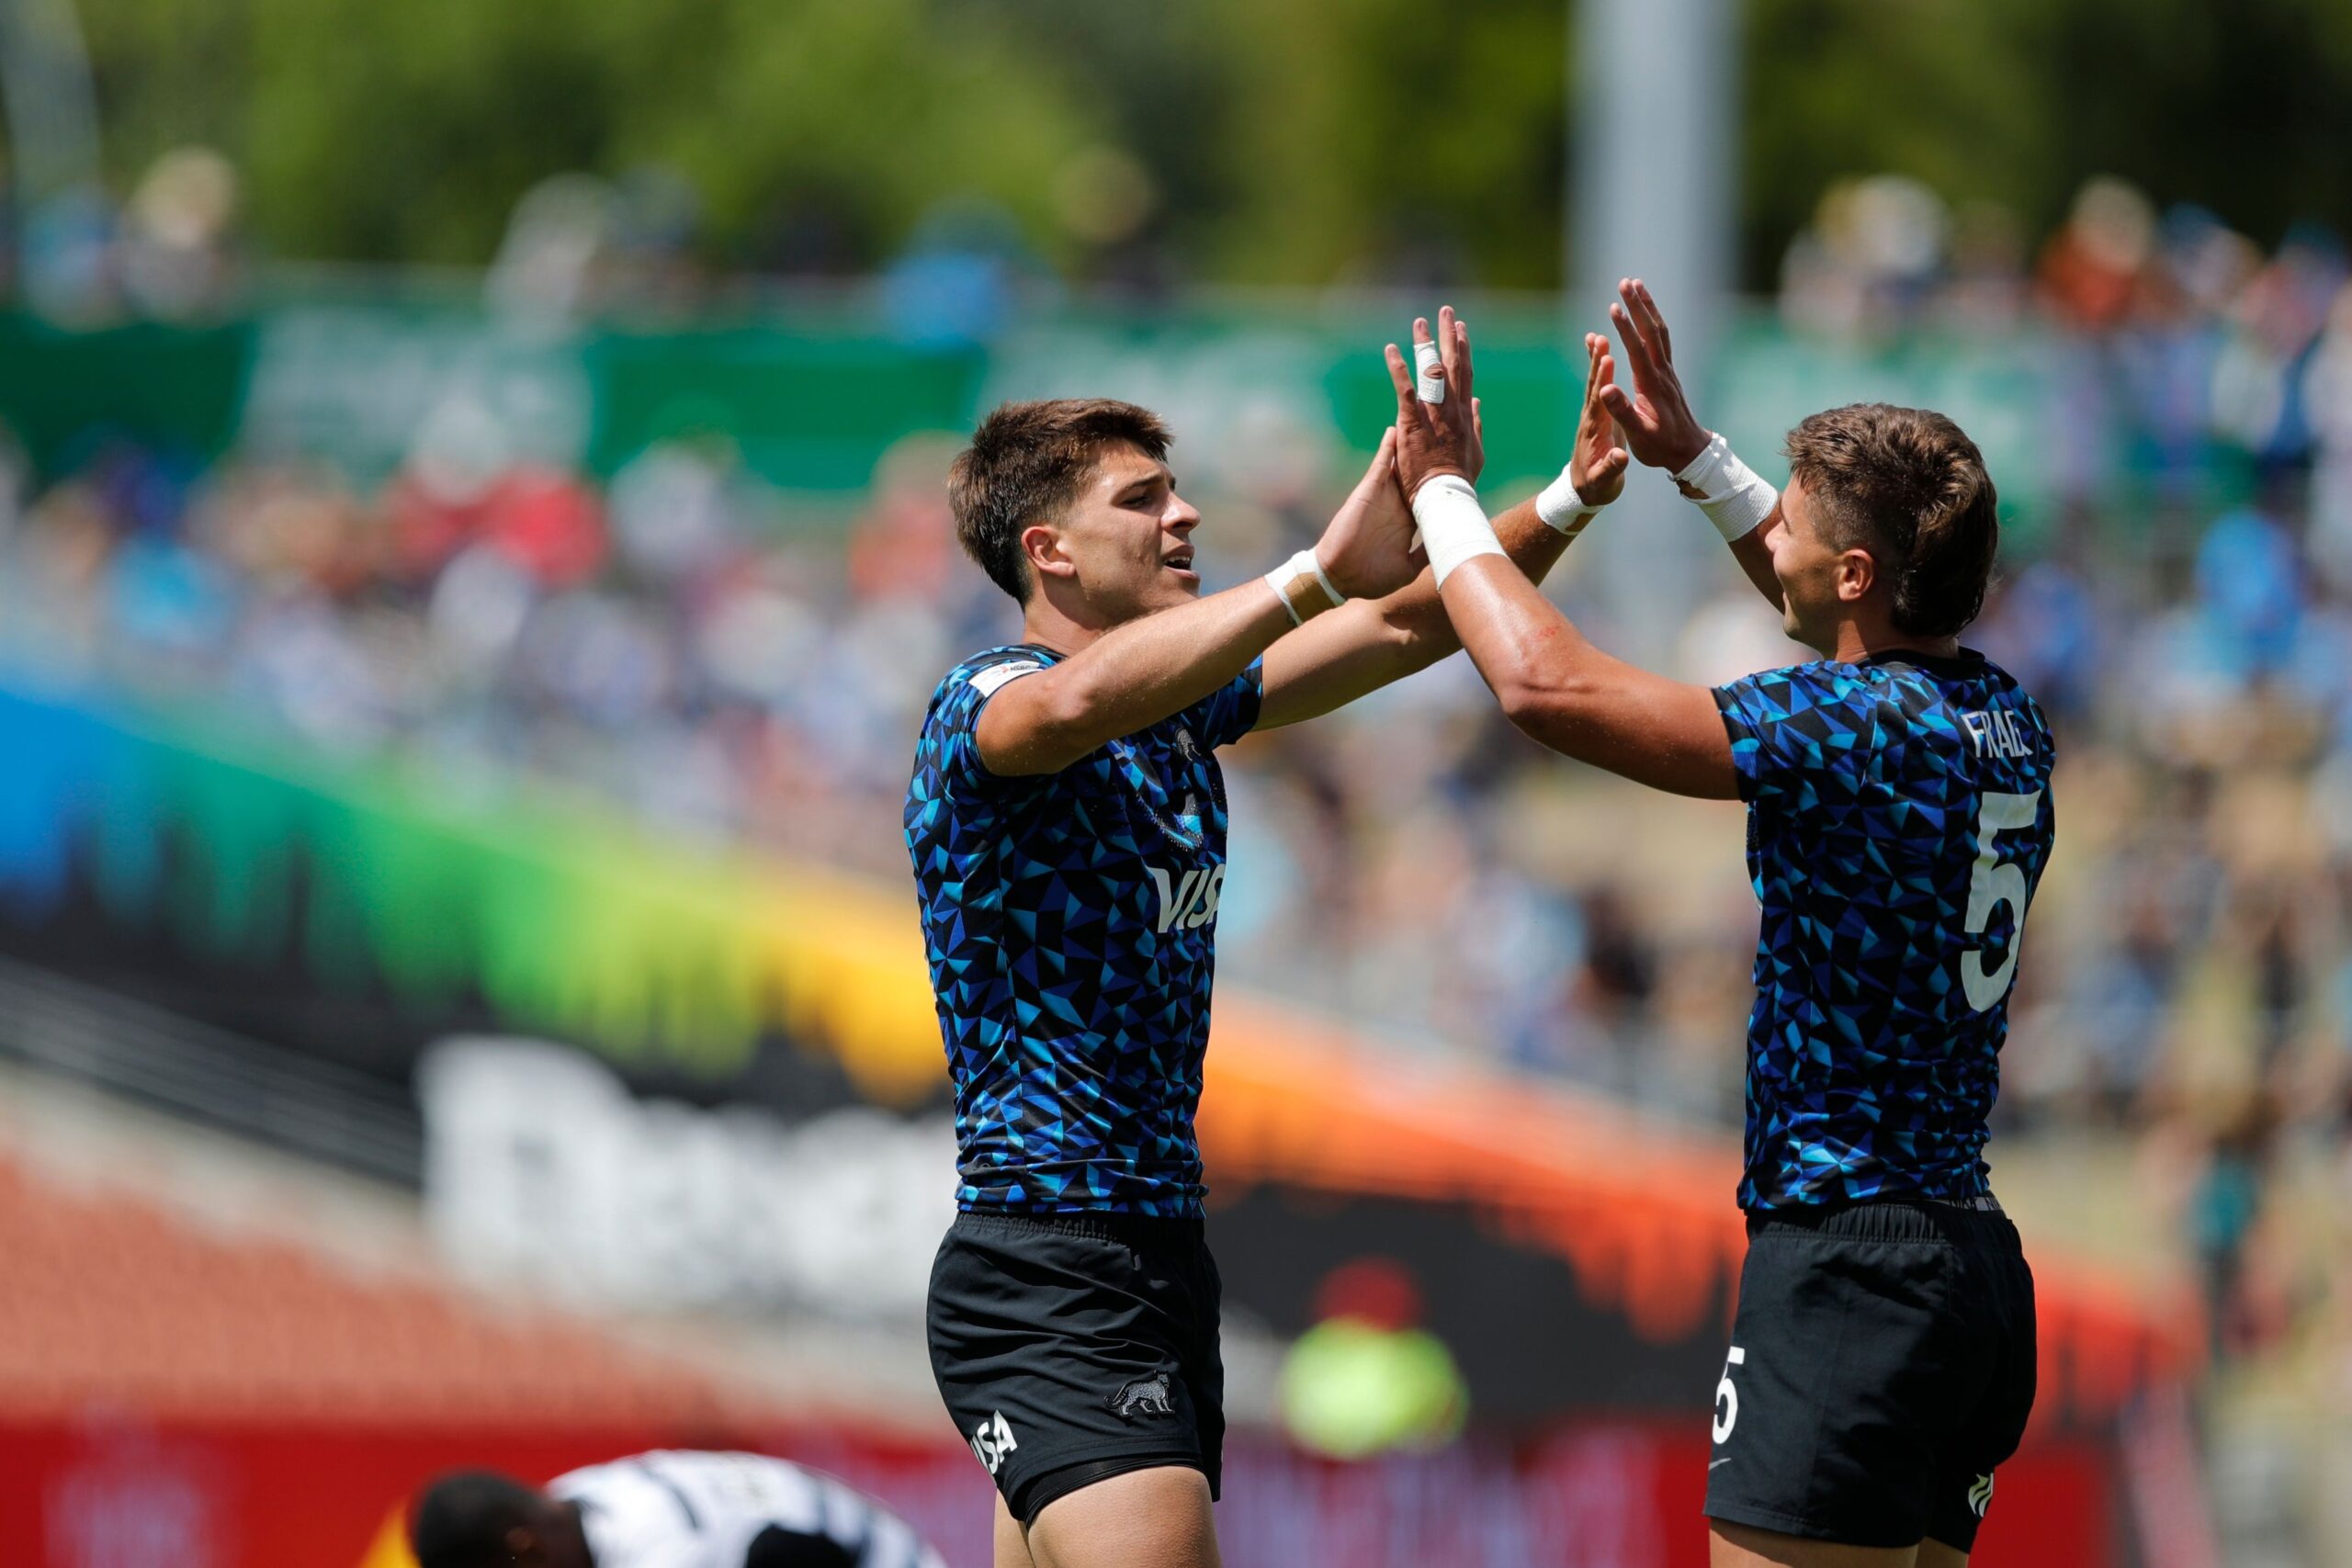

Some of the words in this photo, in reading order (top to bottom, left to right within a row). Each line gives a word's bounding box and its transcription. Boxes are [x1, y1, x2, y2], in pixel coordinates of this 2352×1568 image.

[1145, 863, 1226, 933] VIS
[1961, 790, 2042, 1012] 5
[1712, 1346, 1745, 1445] 5
